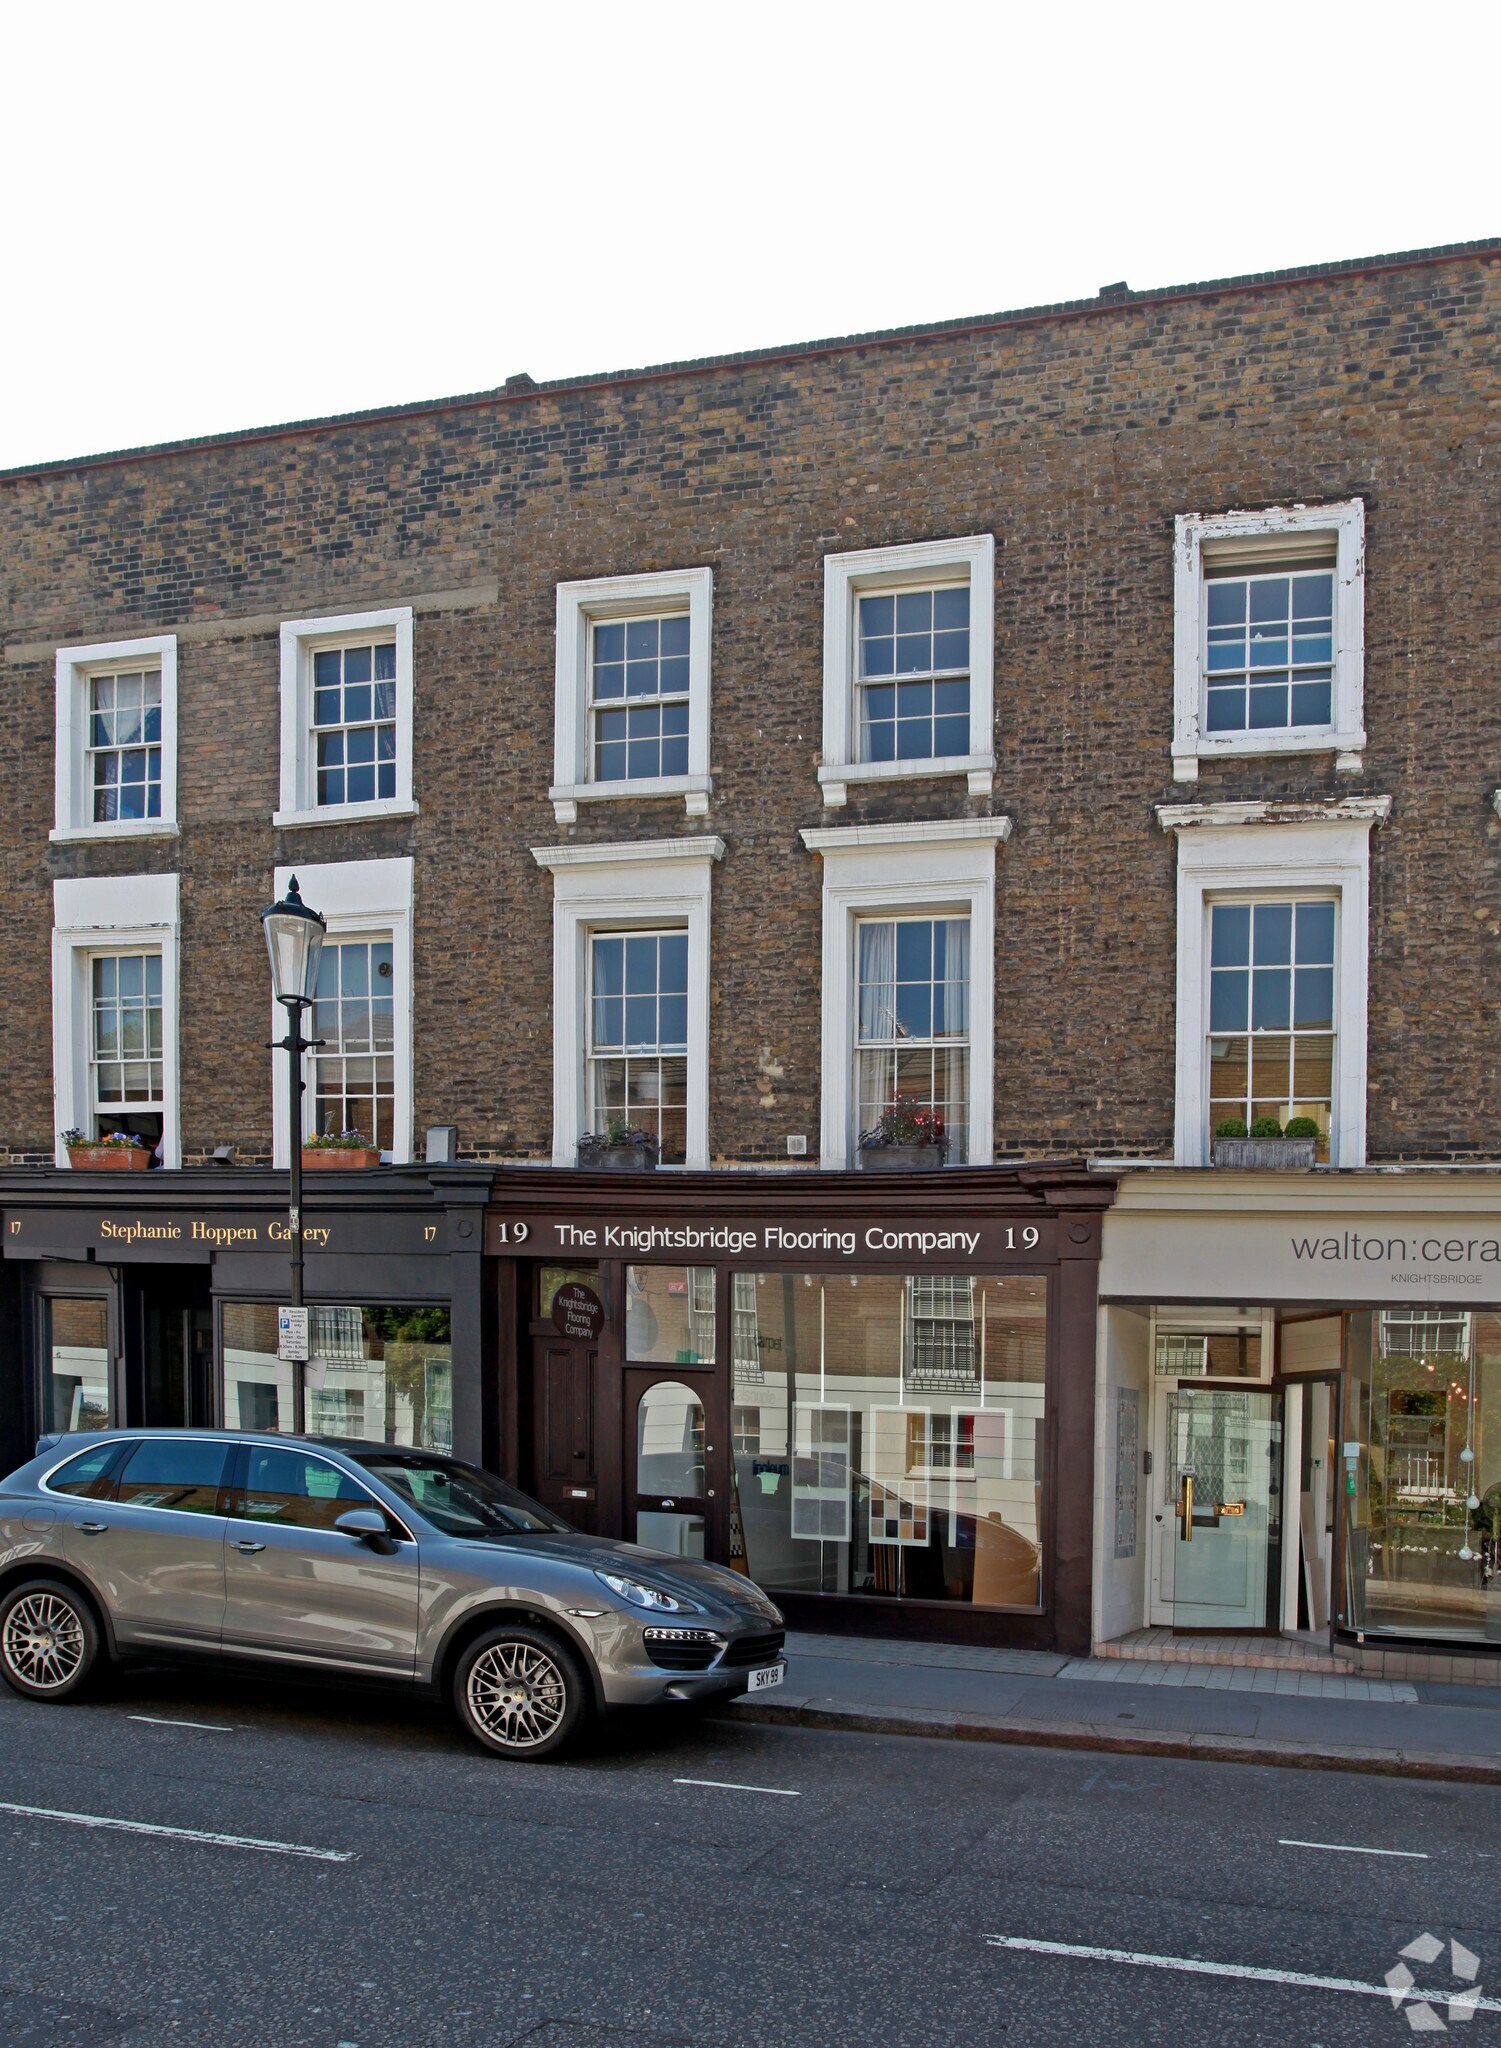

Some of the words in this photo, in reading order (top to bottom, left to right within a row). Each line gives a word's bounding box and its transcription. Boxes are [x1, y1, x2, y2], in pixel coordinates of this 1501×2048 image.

[10, 1221, 22, 1235] 17
[101, 1220, 182, 1244] Stephanie
[191, 1221, 258, 1246] Hoppen
[268, 1221, 332, 1248] Gaery
[424, 1226, 437, 1242] 17
[499, 1222, 528, 1243] 19
[555, 1224, 597, 1246] The
[604, 1225, 757, 1253] Knightsbridge
[765, 1226, 856, 1255] Flooring
[866, 1227, 981, 1255] Company
[1004, 1226, 1039, 1250] 19
[1391, 1273, 1483, 1285] KNIGHTSBRIDGE
[573, 1287, 585, 1299] The
[558, 1295, 599, 1315] Knightsbridge
[567, 1311, 591, 1327] Flooring
[565, 1323, 593, 1340] Company
[756, 1670, 770, 1686] SKY
[770, 1668, 778, 1683] 99
